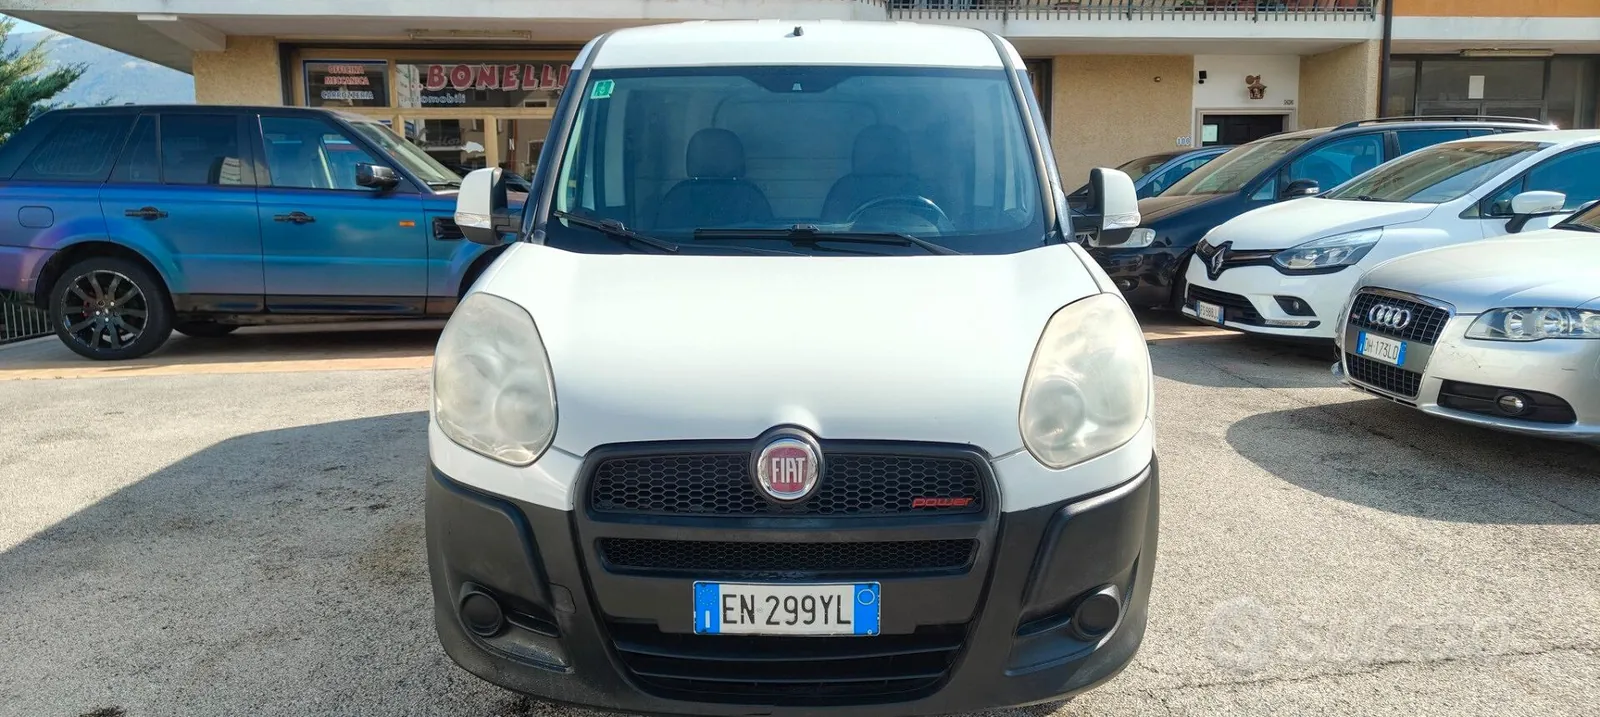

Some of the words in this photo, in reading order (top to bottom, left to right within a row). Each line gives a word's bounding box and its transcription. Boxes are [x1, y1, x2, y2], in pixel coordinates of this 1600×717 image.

[328, 65, 364, 75] OFFICINA
[324, 76, 370, 86] MECCANICA
[1375, 341, 1399, 360] 173LD
[772, 456, 806, 484] FIAT
[912, 496, 974, 508] power
[722, 593, 756, 625] EN
[765, 594, 851, 626] 299YL
